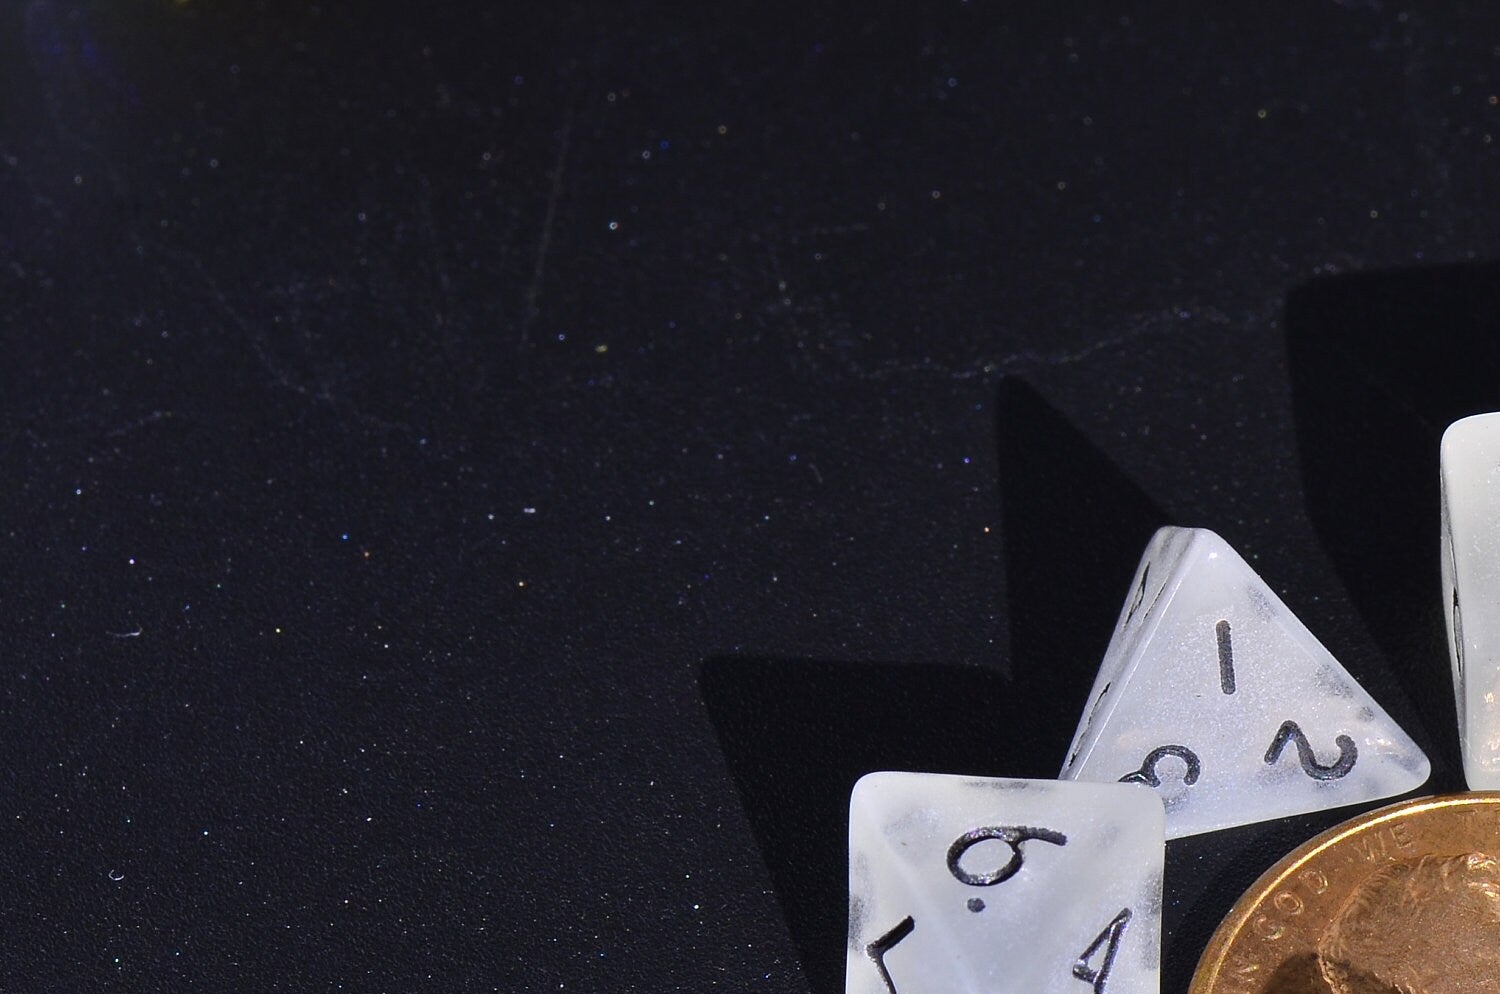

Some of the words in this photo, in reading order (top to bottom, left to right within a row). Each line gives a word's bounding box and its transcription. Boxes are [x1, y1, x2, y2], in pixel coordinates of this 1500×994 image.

[1216, 619, 1236, 695] 1
[1264, 719, 1358, 781] 2
[1252, 870, 1329, 942] GOD
[1353, 824, 1413, 864] WE
